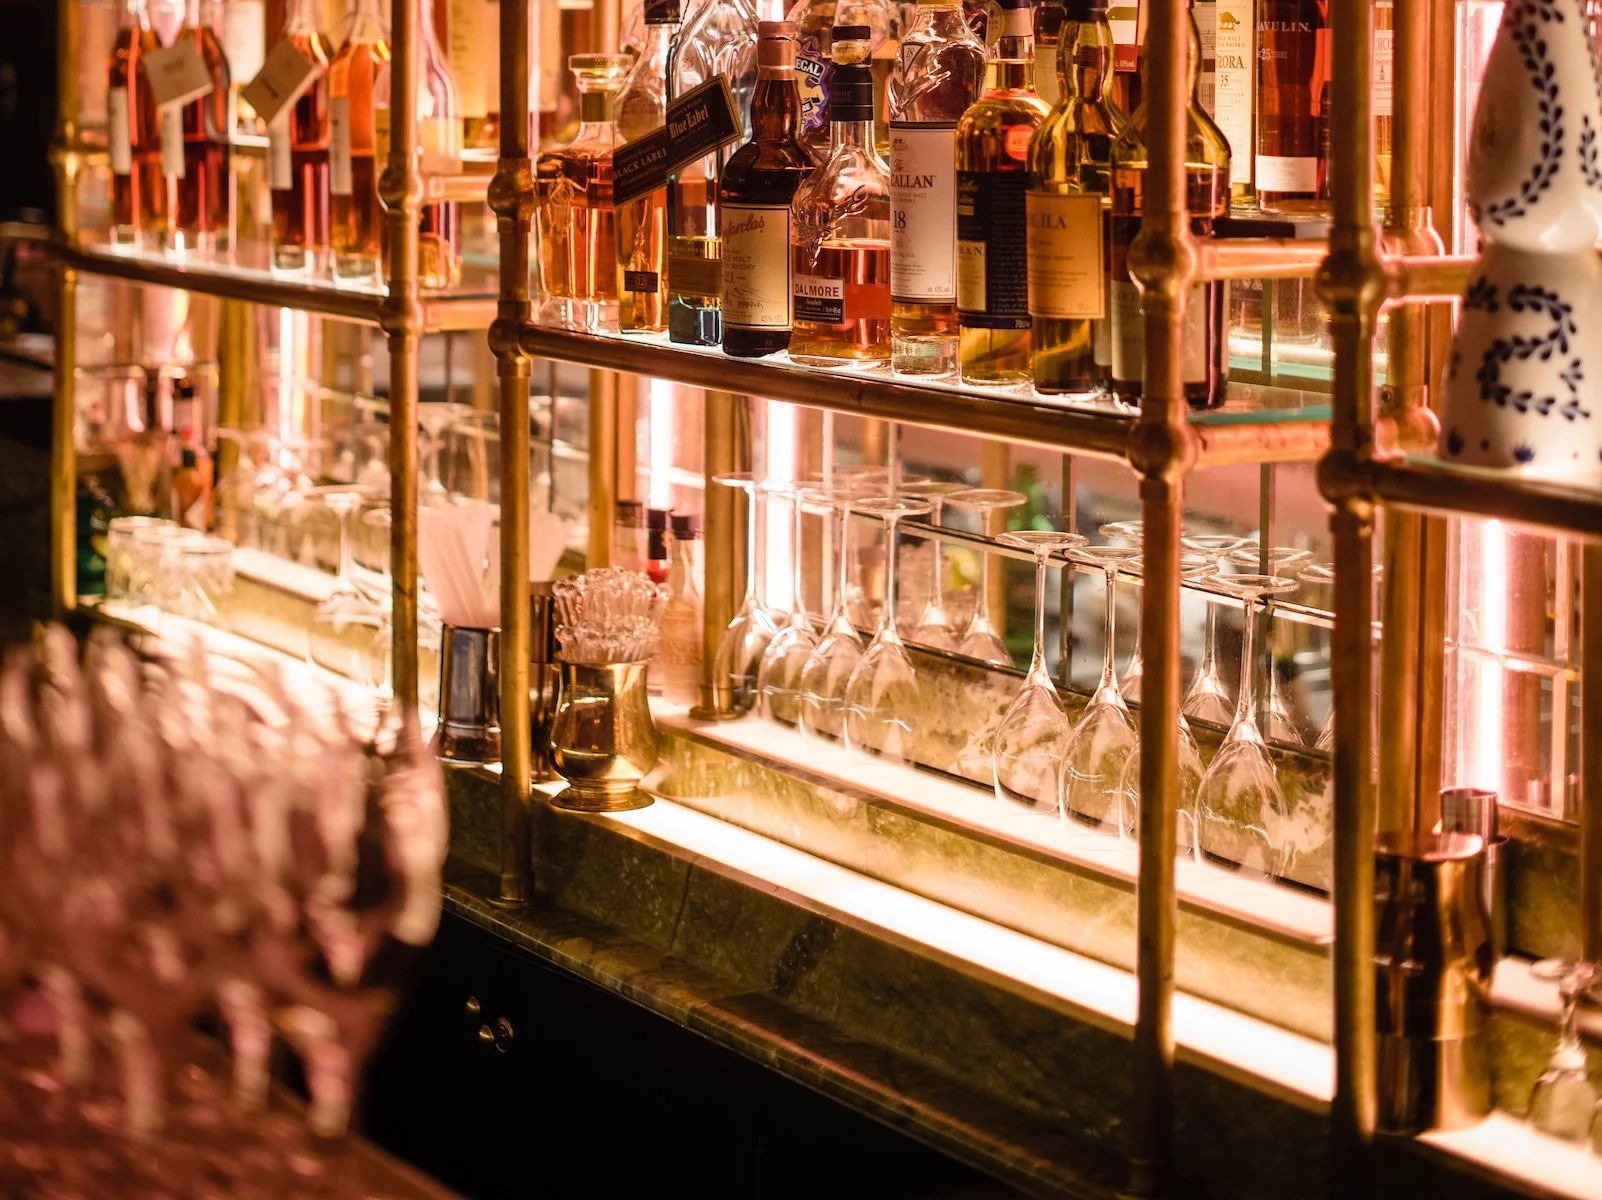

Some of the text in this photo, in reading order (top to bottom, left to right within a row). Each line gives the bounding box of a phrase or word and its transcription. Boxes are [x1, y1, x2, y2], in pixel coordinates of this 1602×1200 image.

[685, 103, 709, 131] Label
[639, 147, 668, 168] LABEL
[893, 210, 906, 229] 18
[794, 283, 840, 297] DALMORE
